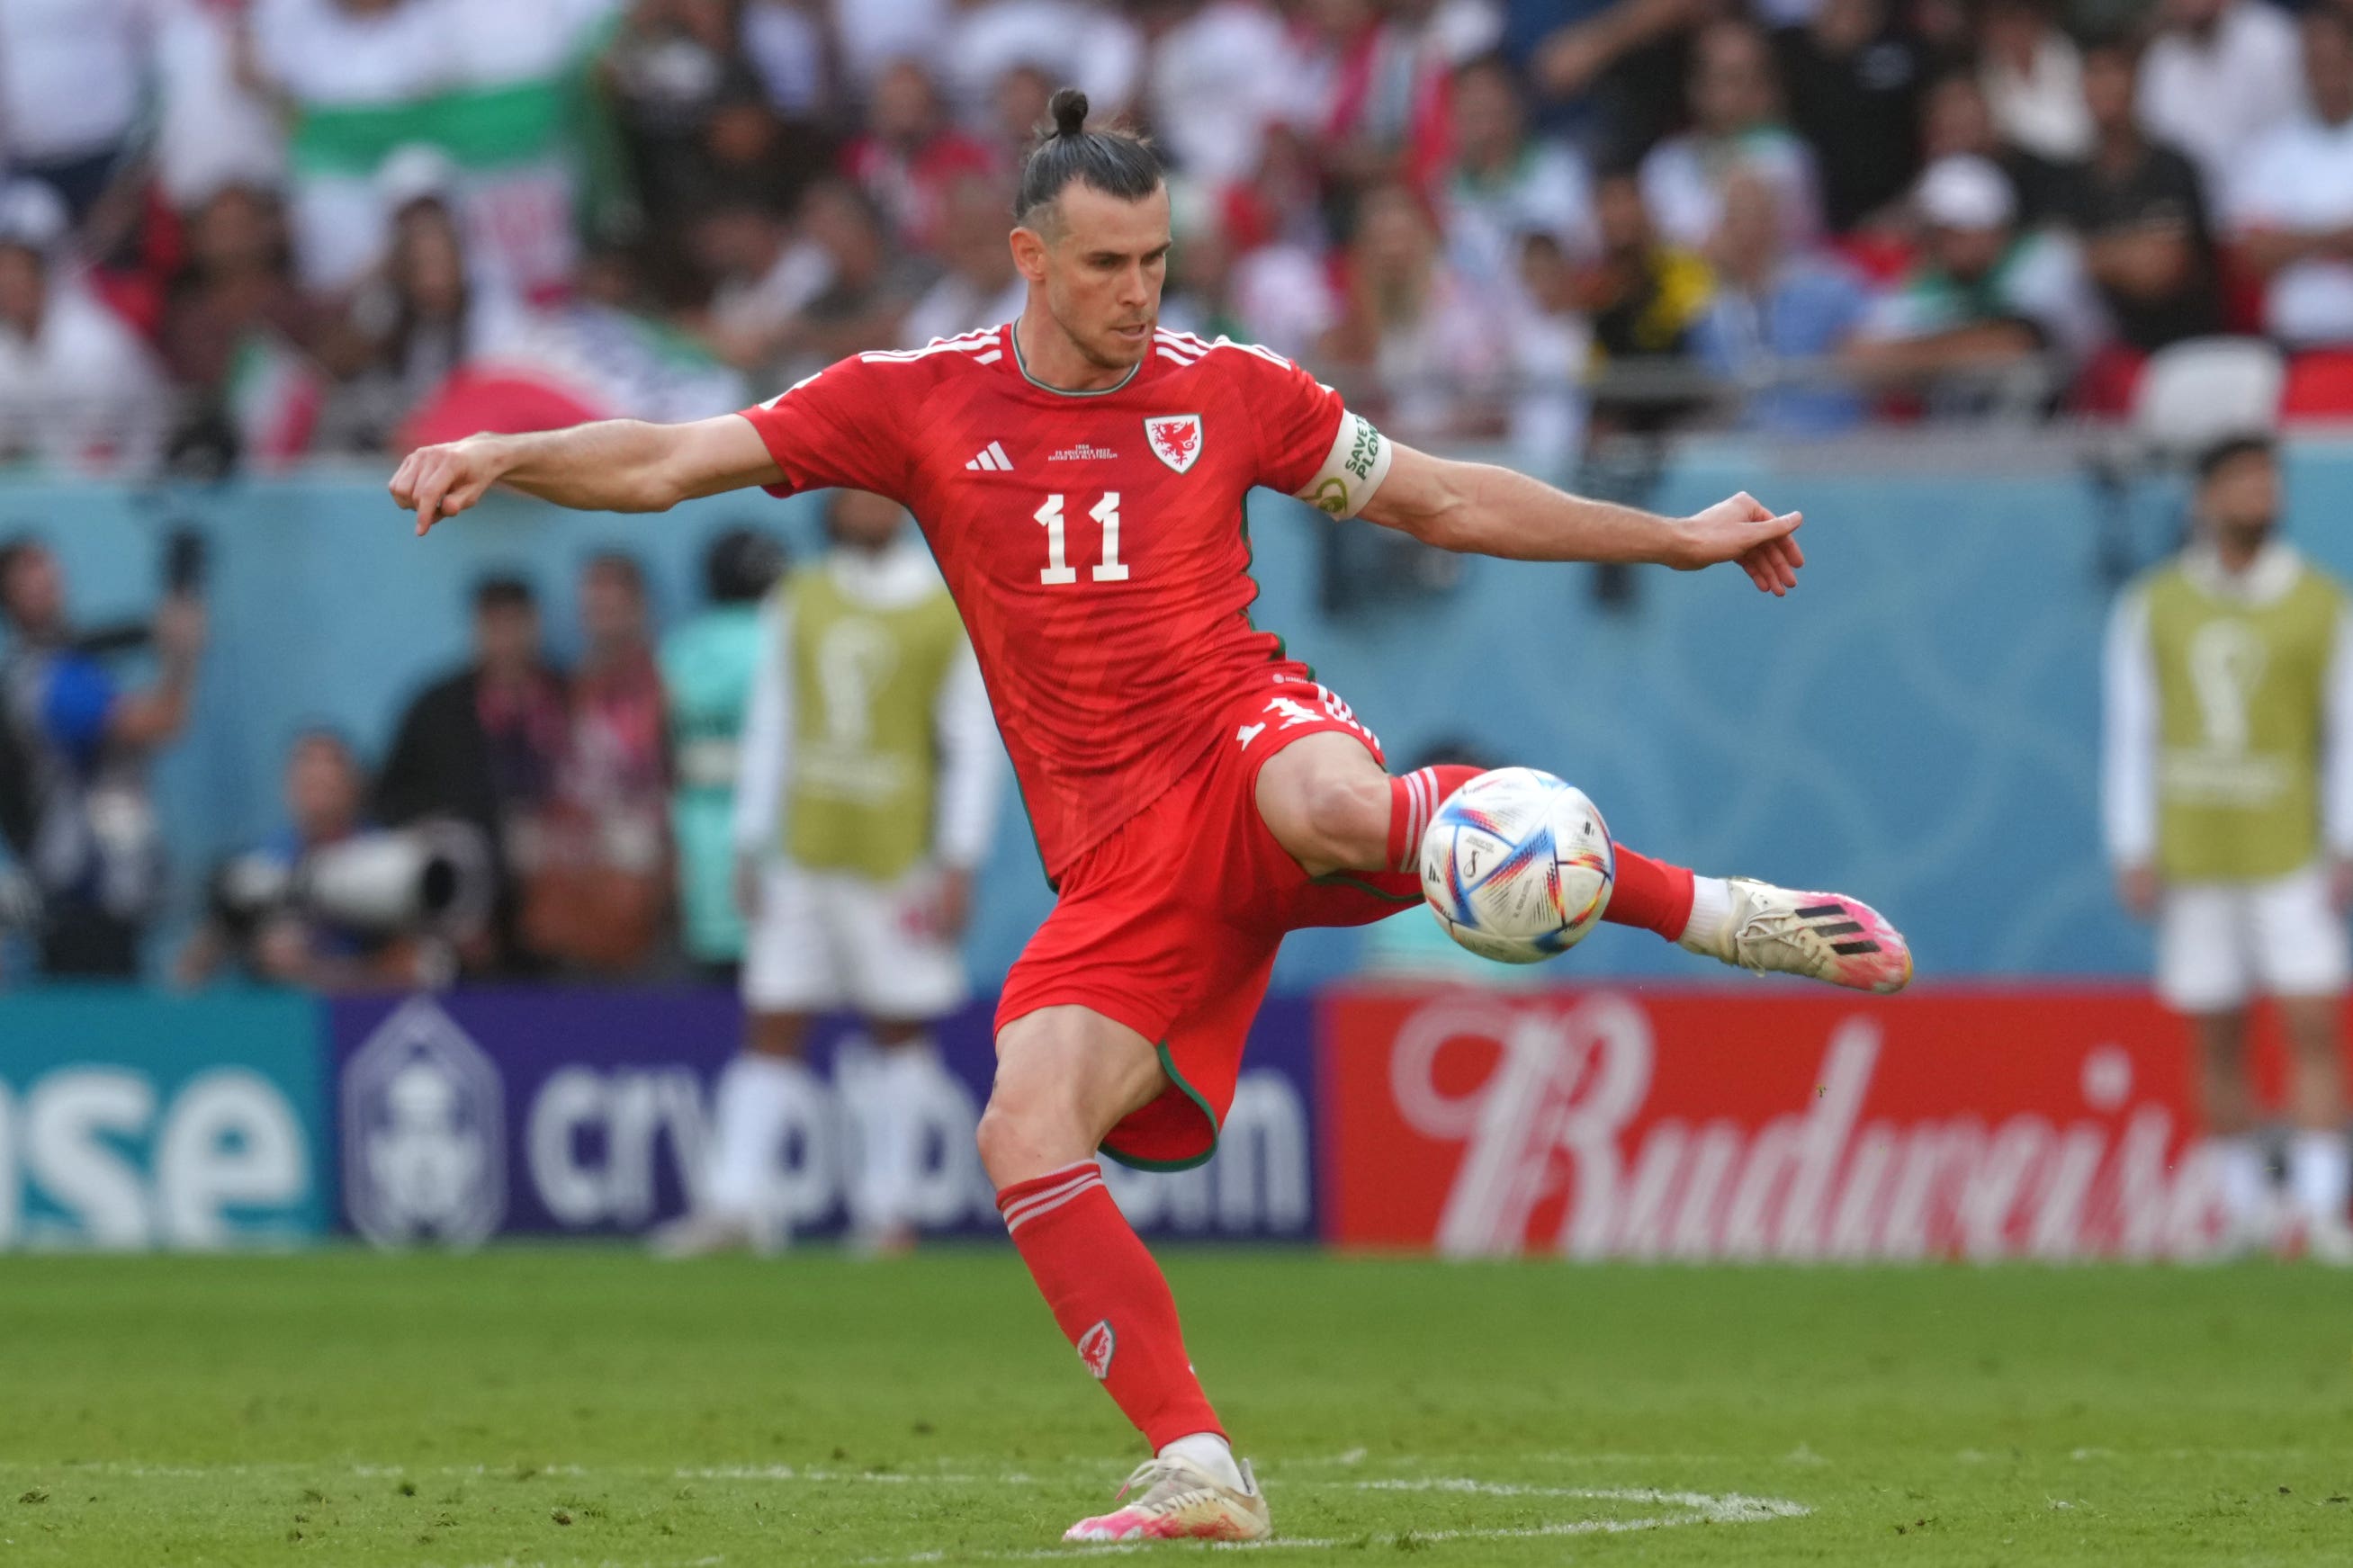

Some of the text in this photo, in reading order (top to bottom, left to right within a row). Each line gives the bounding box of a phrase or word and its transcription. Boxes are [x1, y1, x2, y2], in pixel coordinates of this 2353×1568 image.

[1345, 426, 1368, 471] SAVE
[1356, 424, 1379, 480] PLAN
[1033, 491, 1129, 585] 11
[0, 1064, 310, 1250] se
